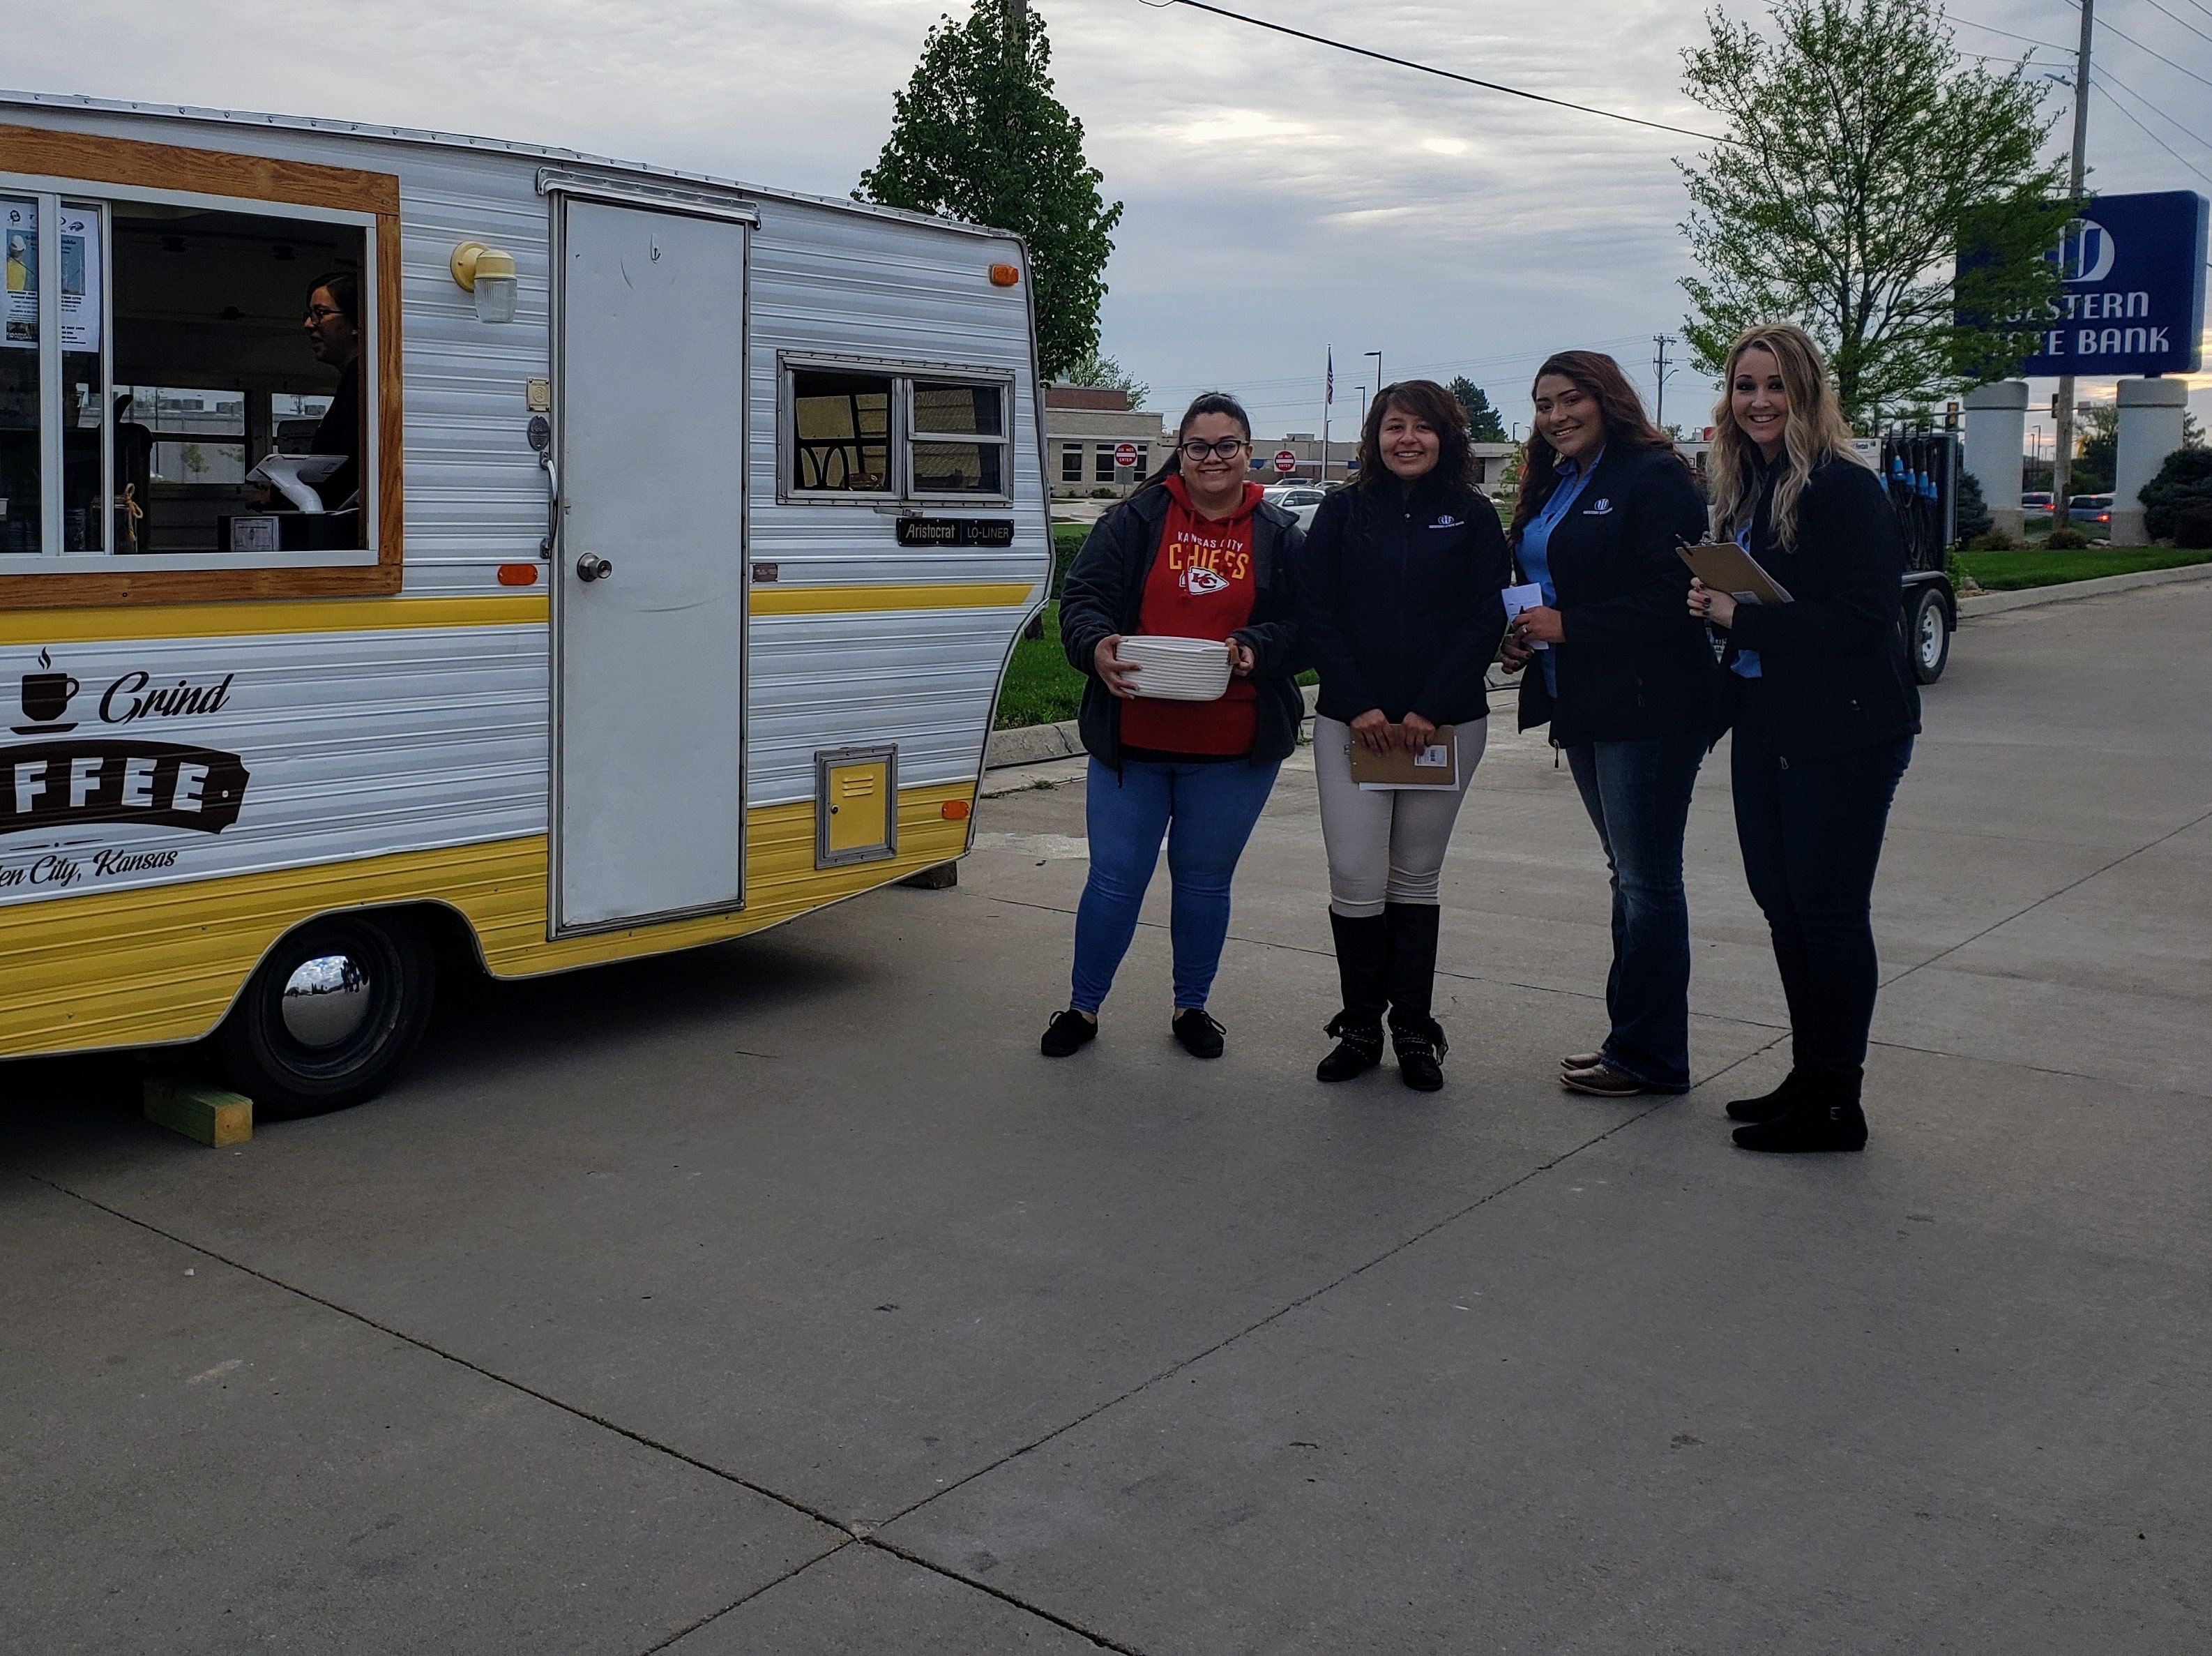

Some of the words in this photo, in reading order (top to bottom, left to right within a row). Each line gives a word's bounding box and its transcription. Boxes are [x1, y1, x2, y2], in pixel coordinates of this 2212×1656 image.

[2077, 326, 2169, 355] BANK
[905, 523, 955, 539] Aristocrat
[967, 526, 1009, 539] LO-LINER
[1177, 531, 1217, 548] KANSAS
[1169, 543, 1249, 580] CHIEFS
[99, 671, 234, 726] Grind
[0, 865, 26, 887] en
[29, 855, 82, 887] City,
[93, 849, 178, 876] Kansas
